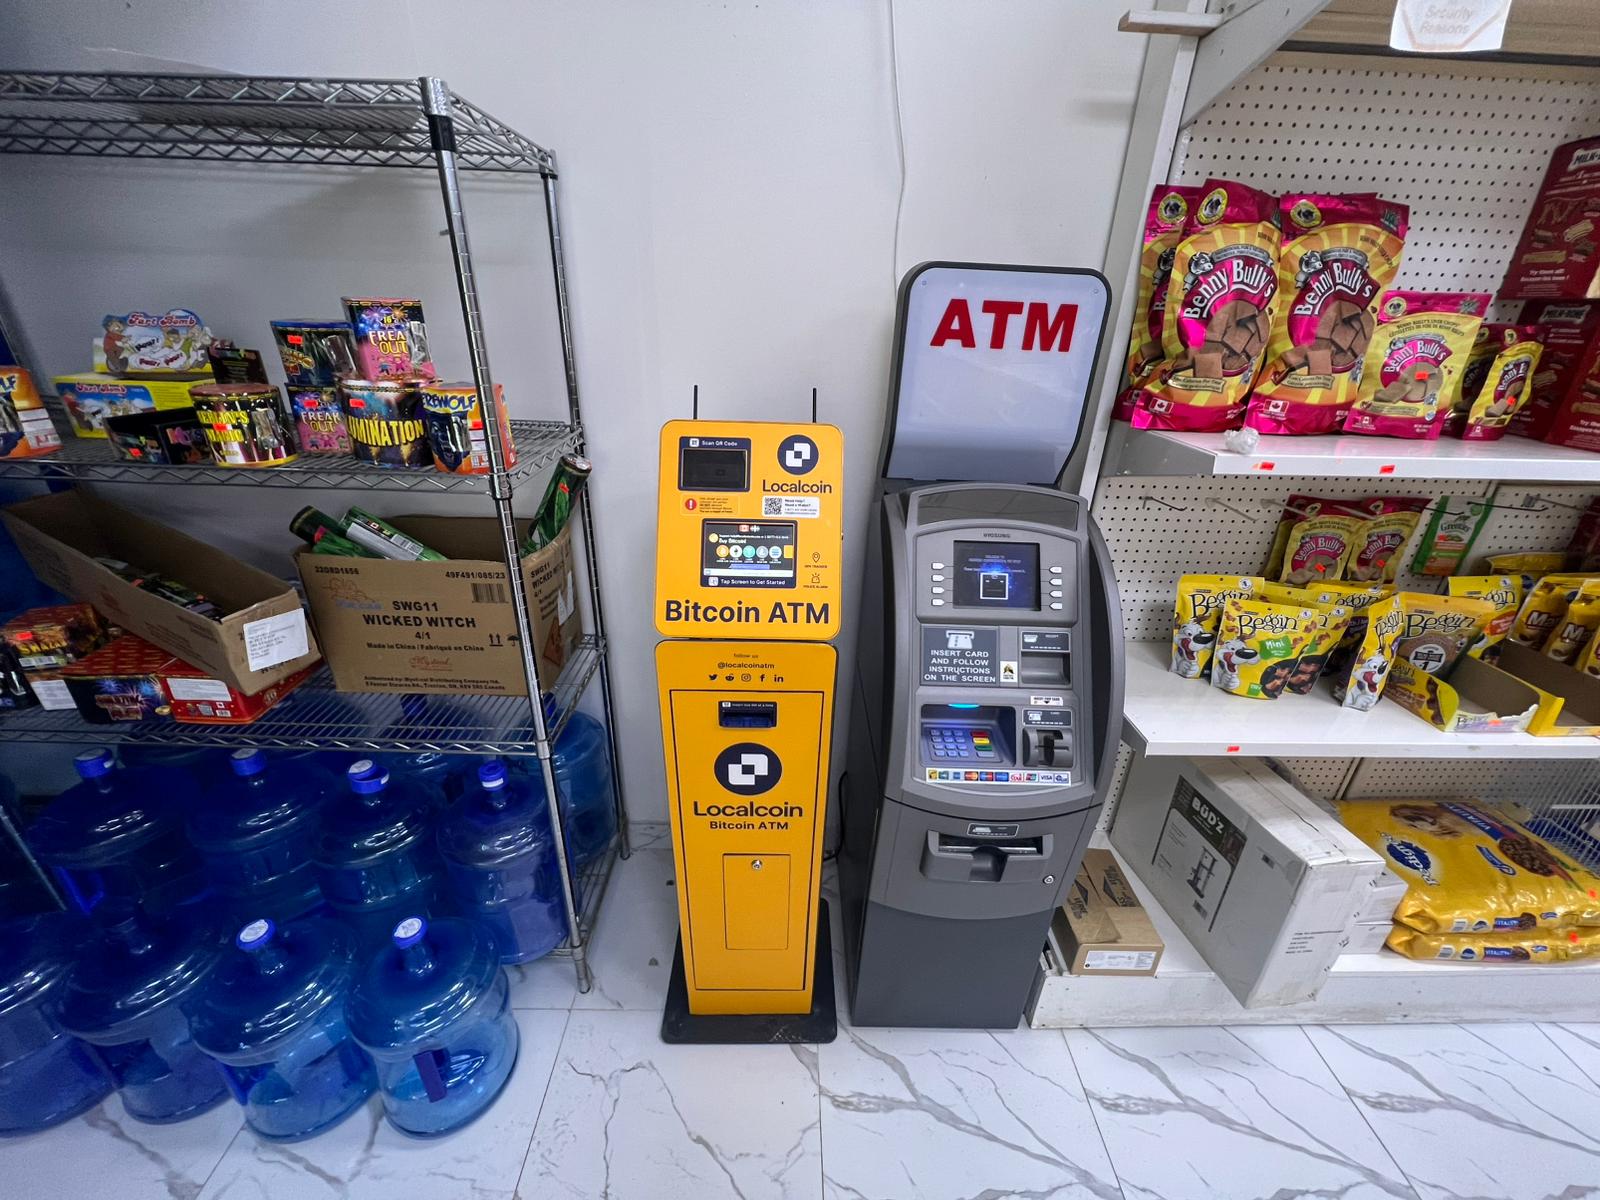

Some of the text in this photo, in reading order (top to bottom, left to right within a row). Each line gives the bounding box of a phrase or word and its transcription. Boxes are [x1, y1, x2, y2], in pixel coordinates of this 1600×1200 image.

[1183, 268, 1229, 319] Benny
[1229, 259, 1274, 298] Bully's
[1293, 262, 1373, 315] Benny Bully's
[128, 313, 197, 327] Fart Bomb
[930, 298, 1079, 352] ATM
[368, 330, 407, 346] FREA
[379, 341, 408, 355] OUT
[1383, 345, 1416, 372] Benny
[301, 412, 341, 426] FREAK
[310, 420, 336, 432] OUT
[762, 479, 832, 494] Localcoin
[392, 600, 439, 612] SWG11
[665, 599, 829, 624] Bitcoin ATM
[362, 614, 477, 628] WICKED WITCH
[415, 631, 431, 640] 4/1
[1265, 639, 1285, 650] Mini
[930, 649, 961, 657] INSERT
[717, 661, 775, 669] @localcoinatm
[953, 658, 989, 666] FOLLOW
[929, 665, 991, 675] INSTRUCTIONS
[941, 674, 958, 682] THE
[961, 675, 996, 683] SCREEN
[694, 801, 803, 818] Localcoin
[709, 820, 789, 830] Bitcoin ATM
